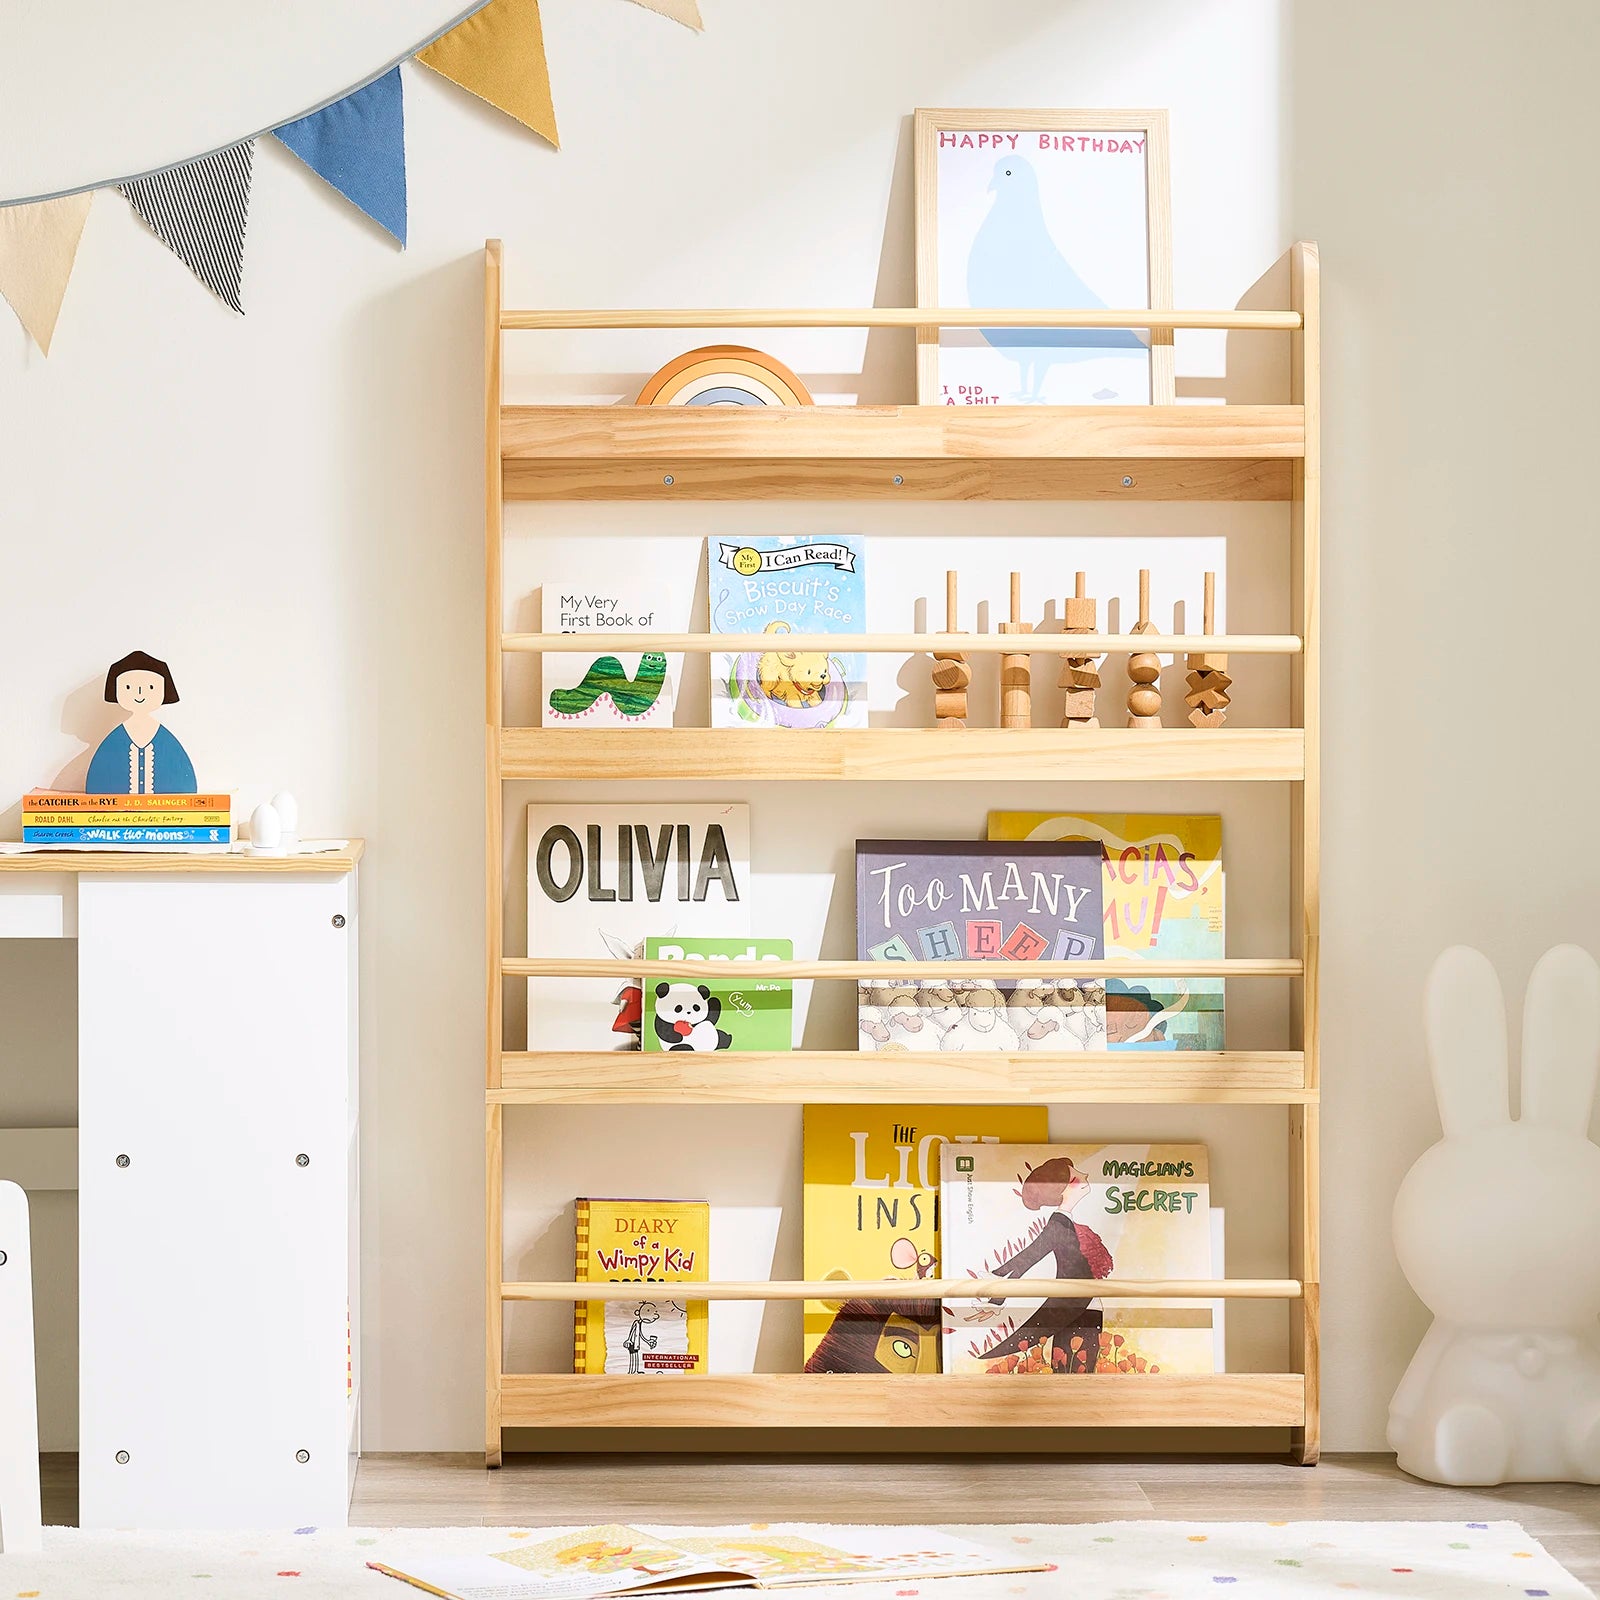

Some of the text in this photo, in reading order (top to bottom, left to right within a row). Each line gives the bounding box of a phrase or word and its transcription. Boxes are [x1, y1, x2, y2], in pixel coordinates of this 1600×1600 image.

[940, 132, 1145, 154] HAPPY BIRTHDAY
[943, 385, 982, 395] I DID
[947, 396, 999, 405] A SHIT
[741, 554, 754, 563] My
[766, 549, 842, 567] I Can Read!
[743, 579, 841, 603] Biscuit's
[561, 595, 619, 612] My Very
[725, 599, 852, 625] Snow Day Race
[561, 612, 655, 626] First Book of
[39, 798, 79, 806] CATCHER
[86, 829, 121, 841] WALK
[122, 829, 144, 841] two
[145, 829, 184, 841] moons
[536, 824, 740, 903] OLIVIA
[869, 862, 1092, 929] Too MANY
[892, 1124, 918, 1143] THE
[1102, 1160, 1195, 1179] MAGICIAN'S
[1104, 1185, 1199, 1215] SECRET
[615, 1218, 678, 1234] DIARY
[633, 1235, 660, 1250] of a
[597, 1247, 695, 1277] Wimpy Kid
